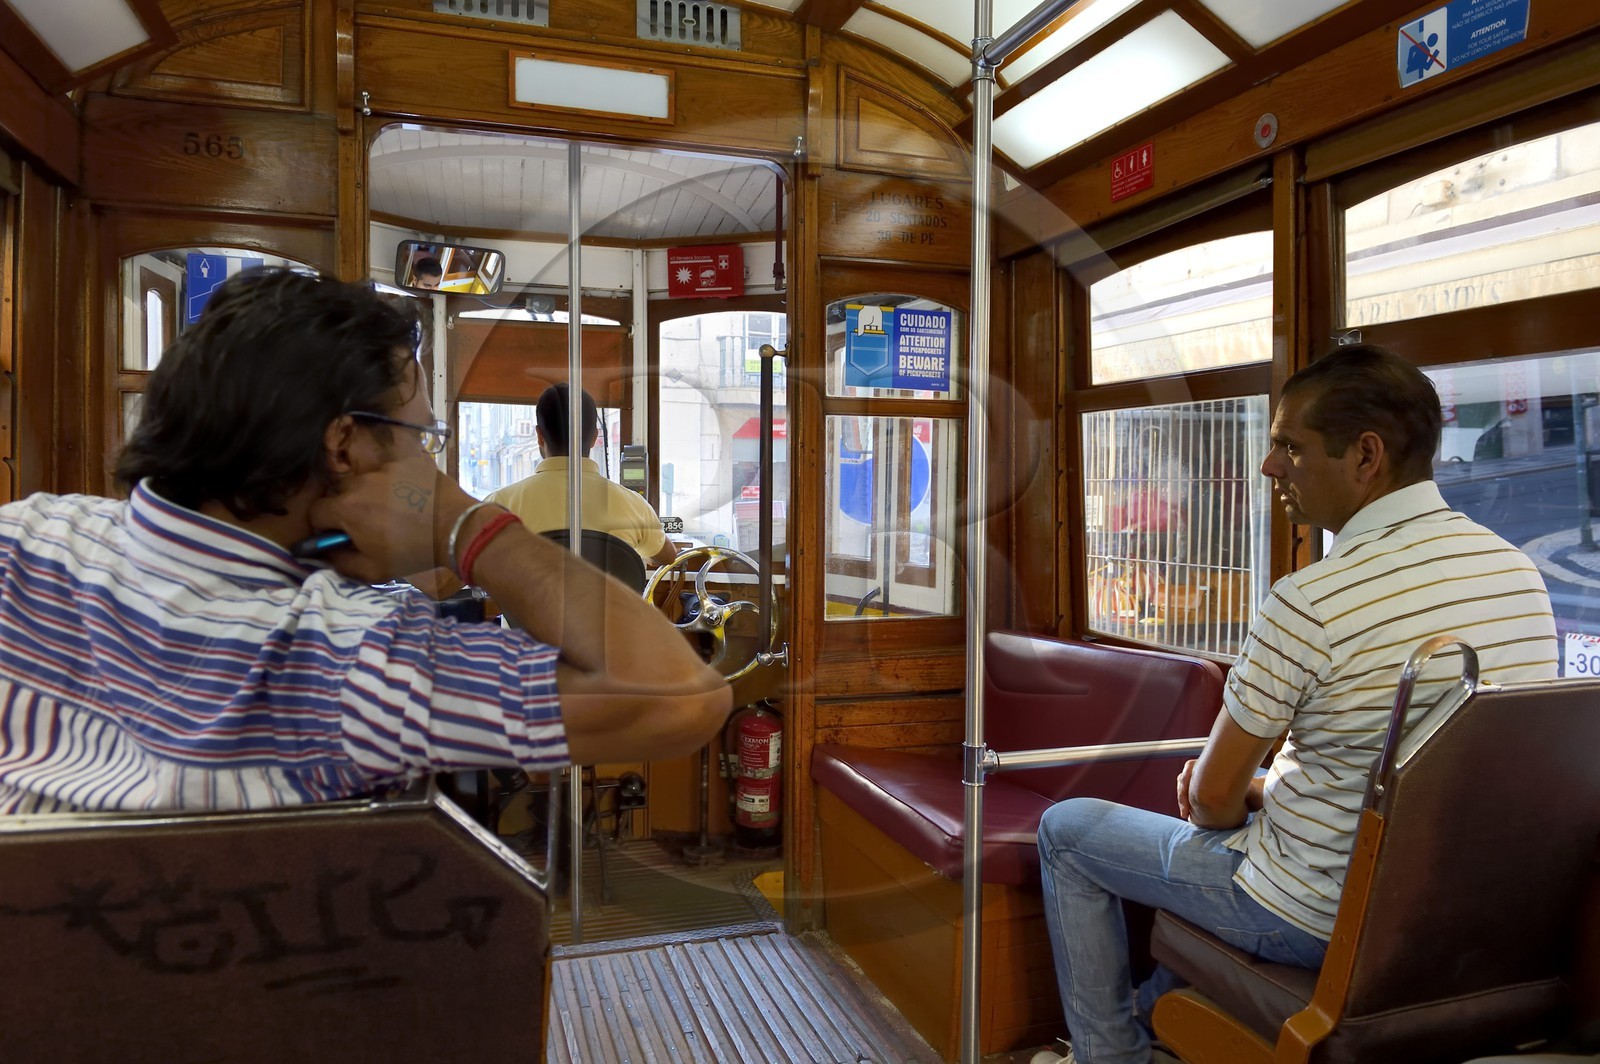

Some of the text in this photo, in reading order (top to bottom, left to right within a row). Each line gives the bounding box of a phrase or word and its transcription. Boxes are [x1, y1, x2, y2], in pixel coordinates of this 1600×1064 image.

[1470, 18, 1507, 39] ATTENTION
[1493, 29, 1510, 40] SAFETY
[1502, 30, 1524, 42] WINDOW
[183, 132, 244, 160] 565
[871, 191, 944, 210] LUGARES
[866, 210, 948, 228] 20 SENTADOS
[901, 231, 916, 244] DE
[900, 313, 946, 329] CUIDADO
[900, 335, 946, 348] ATTENTION
[910, 347, 943, 355] PICKPOCKETS
[899, 355, 945, 371] BEWARE
[907, 369, 942, 378] PICKPOCKETS
[1569, 653, 1600, 676] -30
